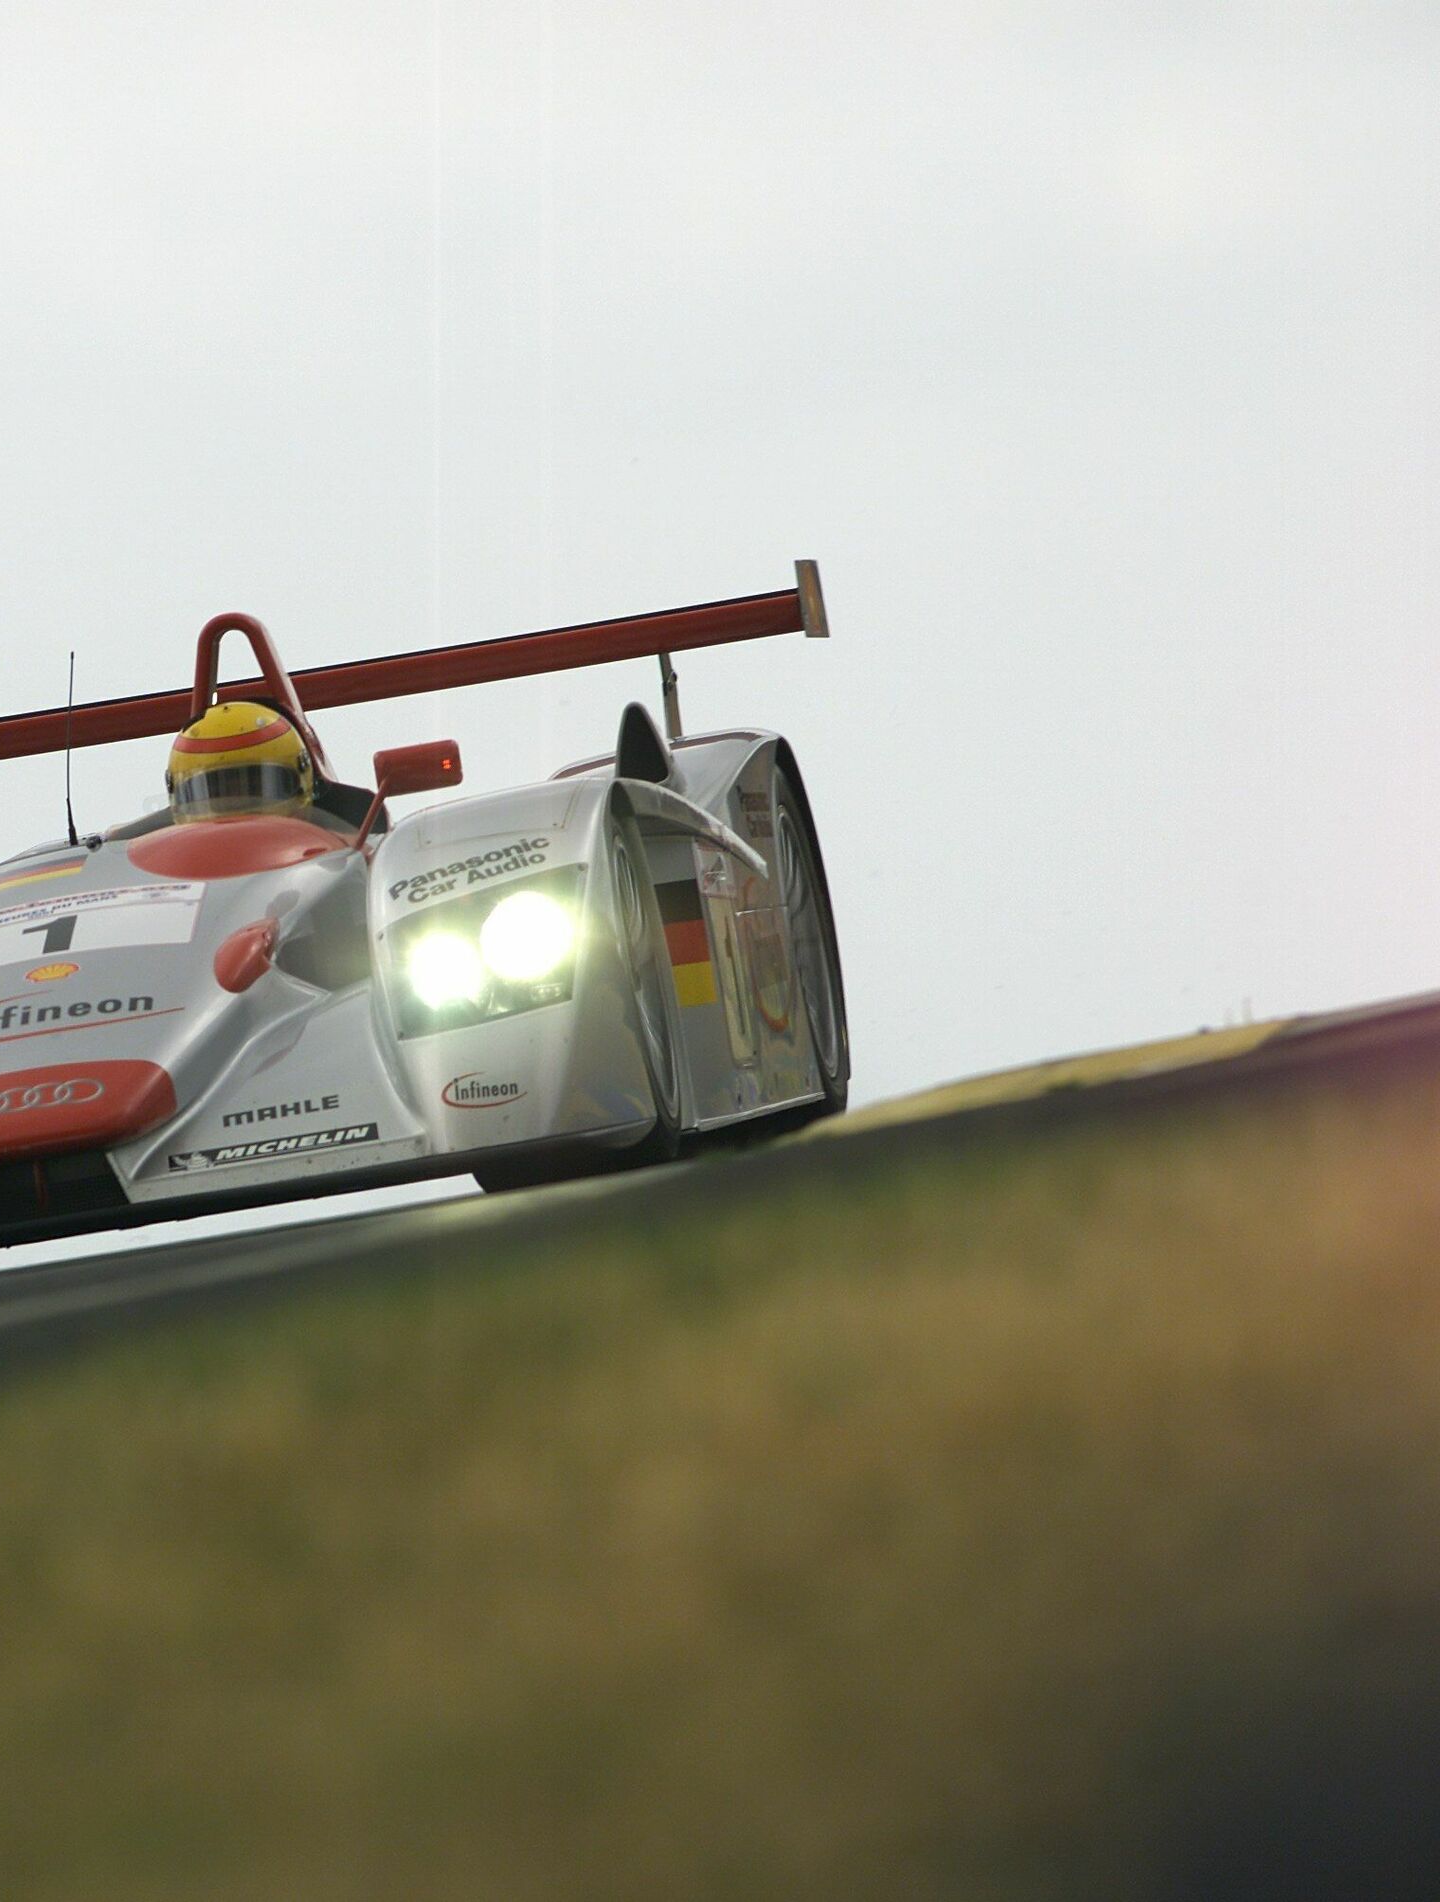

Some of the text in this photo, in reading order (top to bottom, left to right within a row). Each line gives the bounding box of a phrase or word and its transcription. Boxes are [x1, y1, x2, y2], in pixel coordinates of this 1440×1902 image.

[388, 837, 550, 900] Panasonic
[408, 853, 546, 903] Car Audio
[22, 915, 78, 954] 1
[222, 1094, 340, 1127] MAHLE
[215, 1126, 370, 1160] MICHELIN
